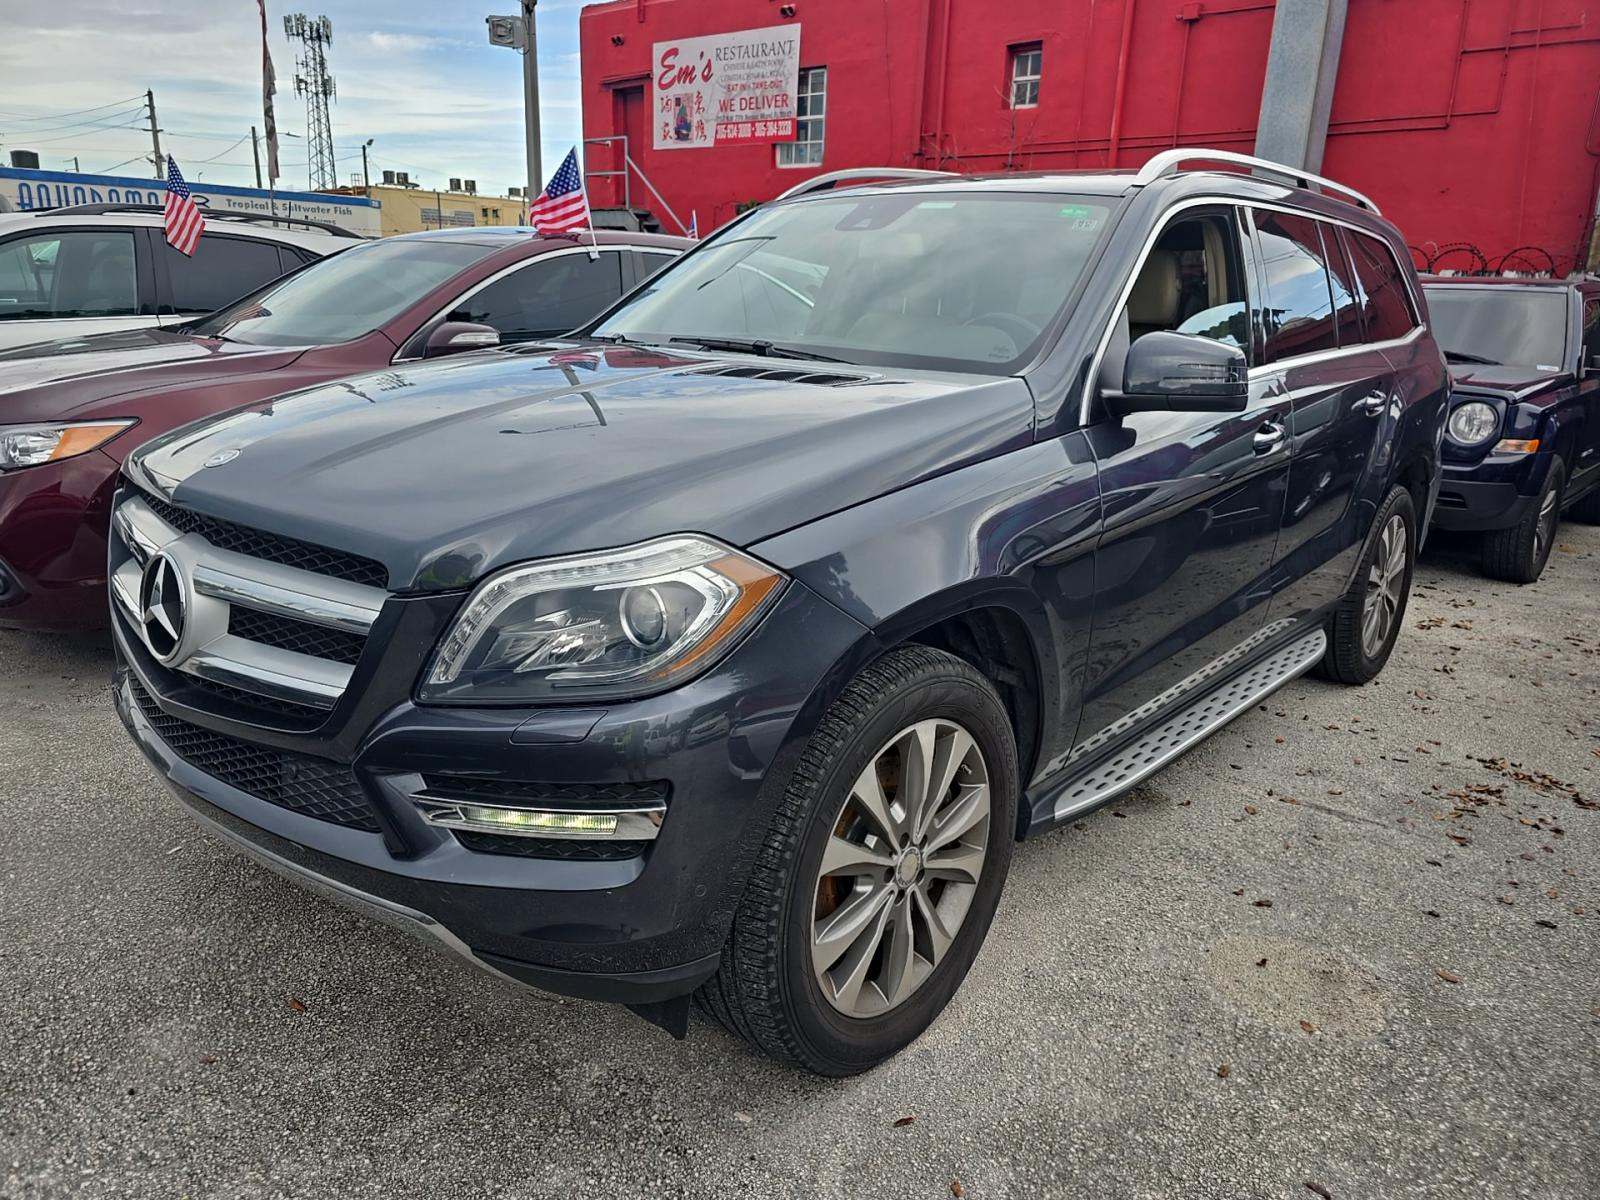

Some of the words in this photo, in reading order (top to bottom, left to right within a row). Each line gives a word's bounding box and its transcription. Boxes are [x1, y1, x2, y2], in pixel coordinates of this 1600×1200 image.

[715, 39, 795, 62] RESTAURANT
[658, 47, 714, 91] Em's
[719, 98, 735, 112] WE
[739, 93, 789, 111] DELIVER
[225, 198, 269, 211] Tropical
[333, 206, 353, 216] Fish
